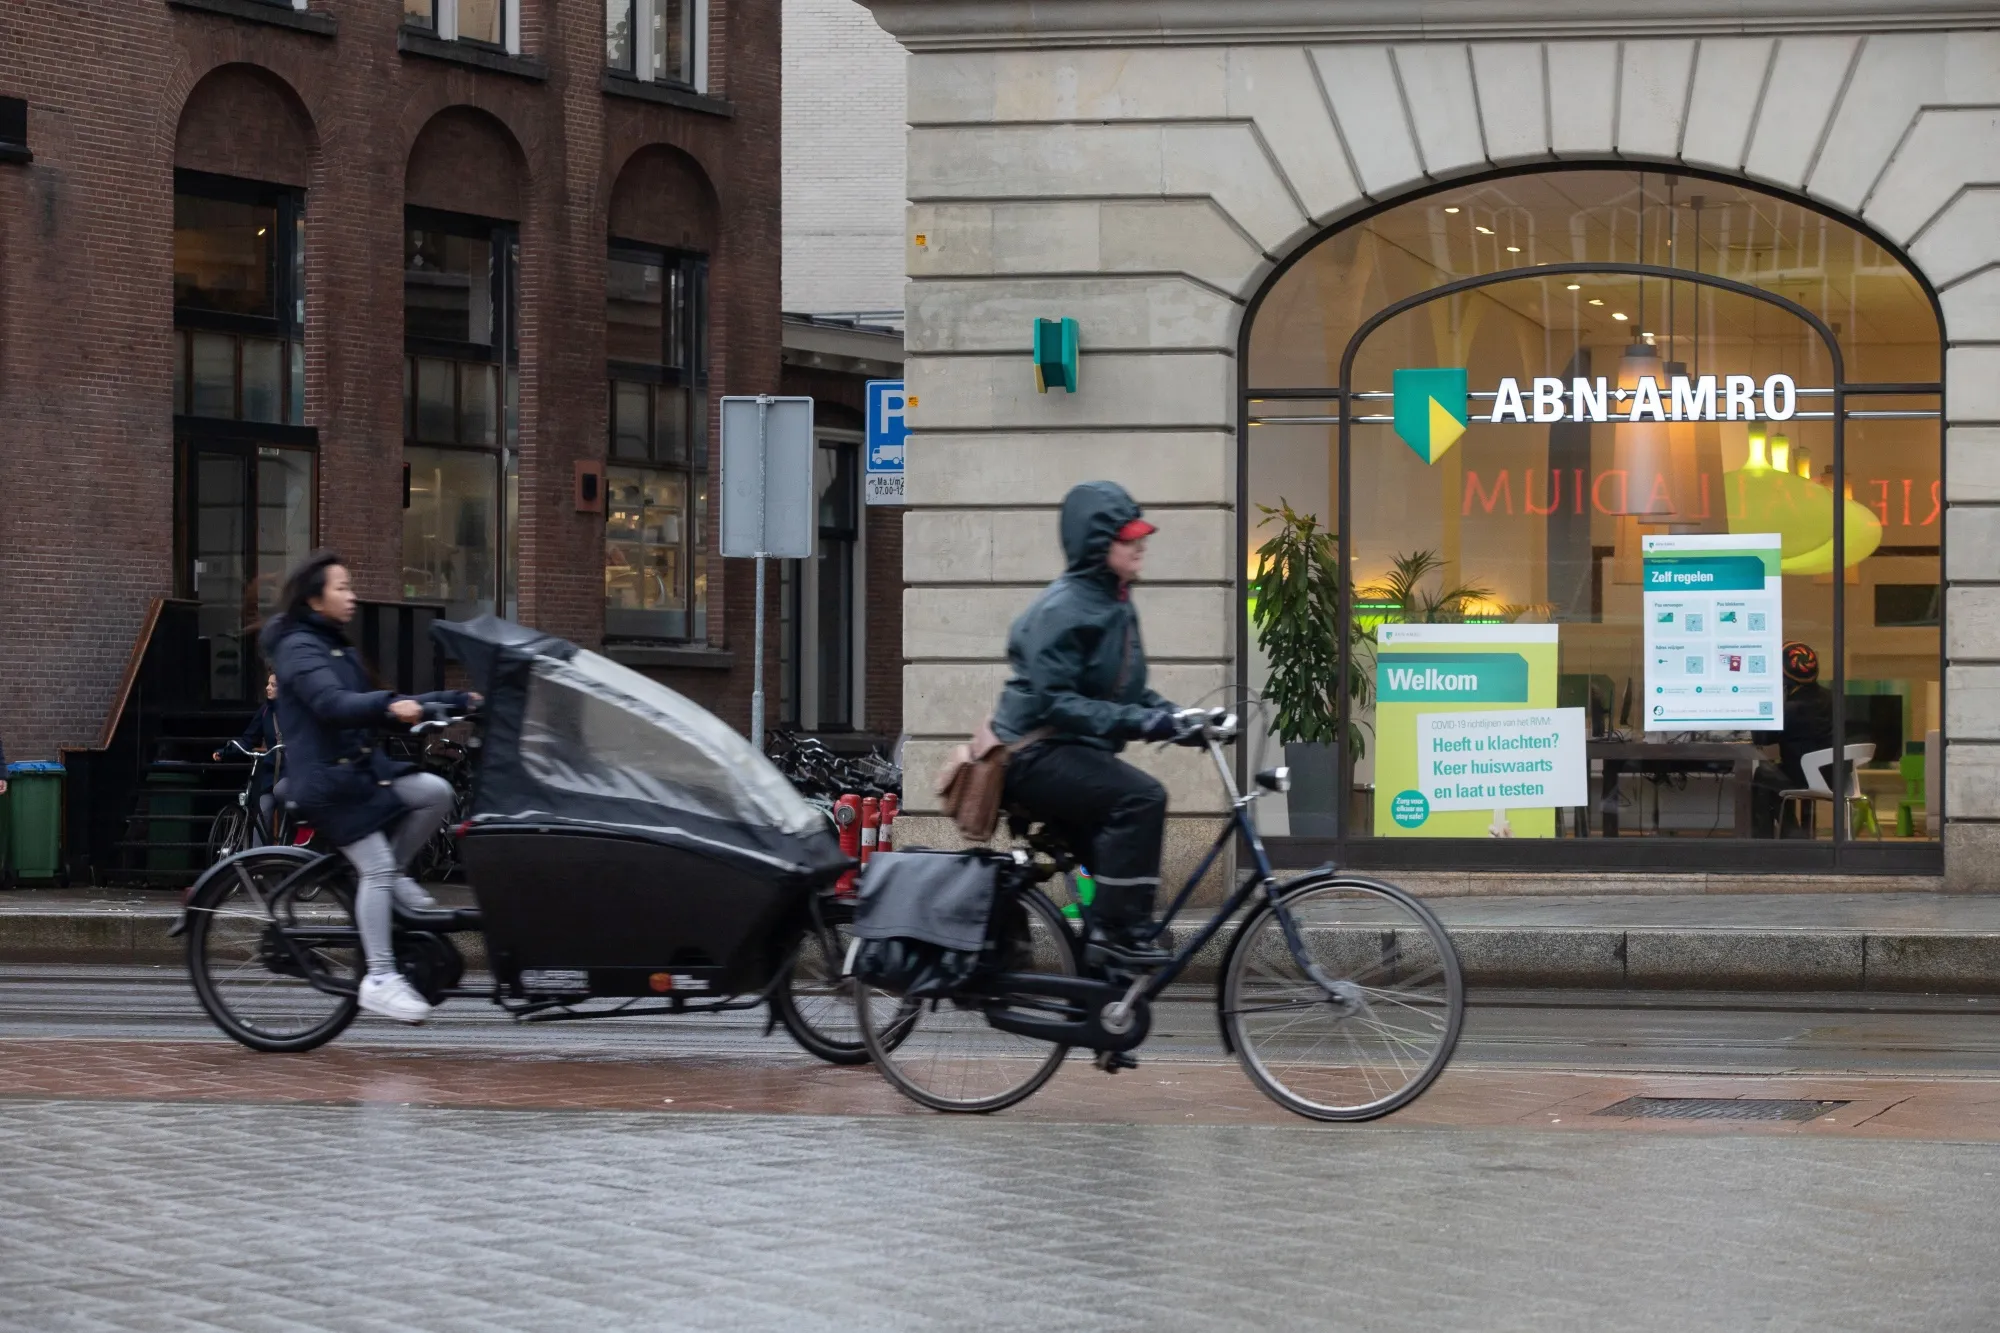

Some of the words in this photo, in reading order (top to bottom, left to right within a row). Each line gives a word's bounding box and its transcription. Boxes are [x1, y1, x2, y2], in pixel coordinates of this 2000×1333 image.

[1489, 376, 1608, 423] ABN
[1628, 373, 1797, 422] AMRO
[880, 390, 904, 434] P
[1652, 571, 1672, 582] Zelf
[1674, 570, 1714, 584] regelen
[1387, 668, 1478, 690] Welkom
[1431, 720, 1466, 730] COVID-19
[1503, 719, 1516, 728] van
[1517, 718, 1529, 726] het
[1433, 736, 1471, 752] Heeft
[1475, 740, 1484, 751] u
[1488, 732, 1559, 750] klachten?
[1433, 760, 1467, 776] Keer
[1471, 758, 1553, 774] huiswaarts
[1434, 786, 1452, 799] en
[1456, 783, 1484, 798] laat
[1487, 786, 1496, 797] u
[1499, 782, 1544, 796] testen
